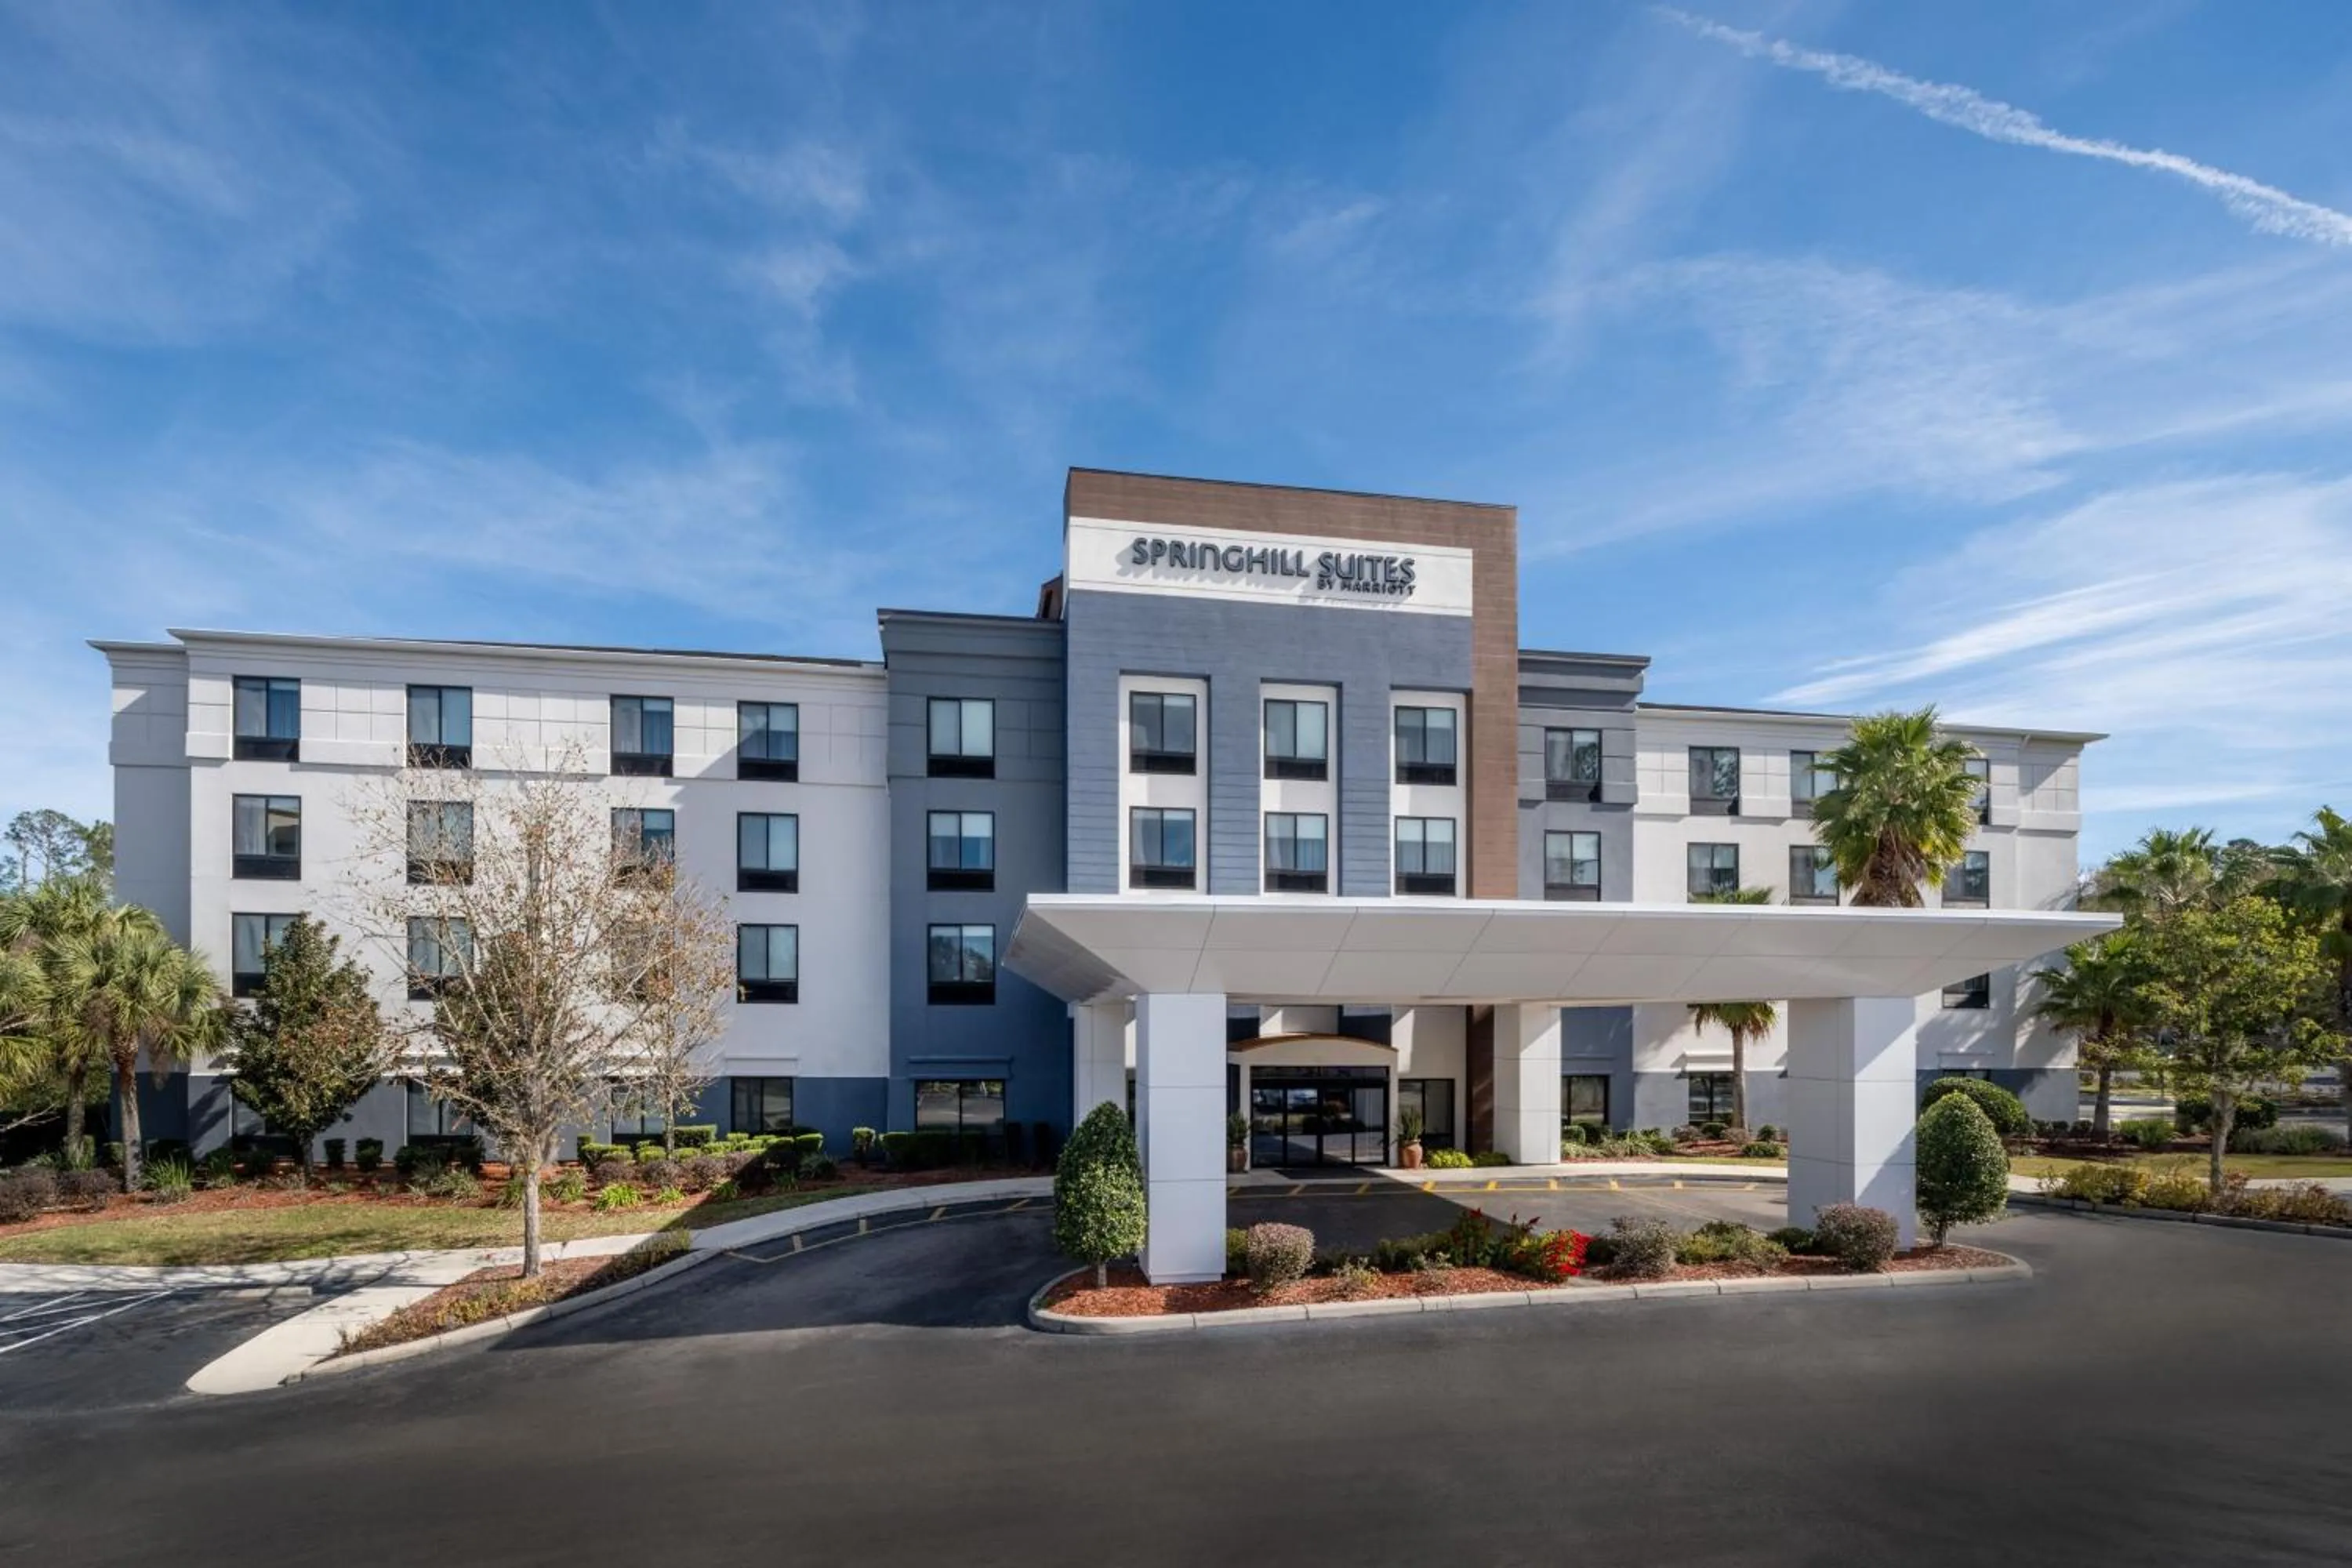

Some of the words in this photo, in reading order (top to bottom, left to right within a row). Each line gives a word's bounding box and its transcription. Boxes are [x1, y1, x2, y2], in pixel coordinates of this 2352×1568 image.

[1132, 537, 1310, 578] SPRINGHILL
[1318, 552, 1416, 583] SUITES
[1317, 579, 1334, 590] BY
[1341, 582, 1416, 596] MARRIOTT
